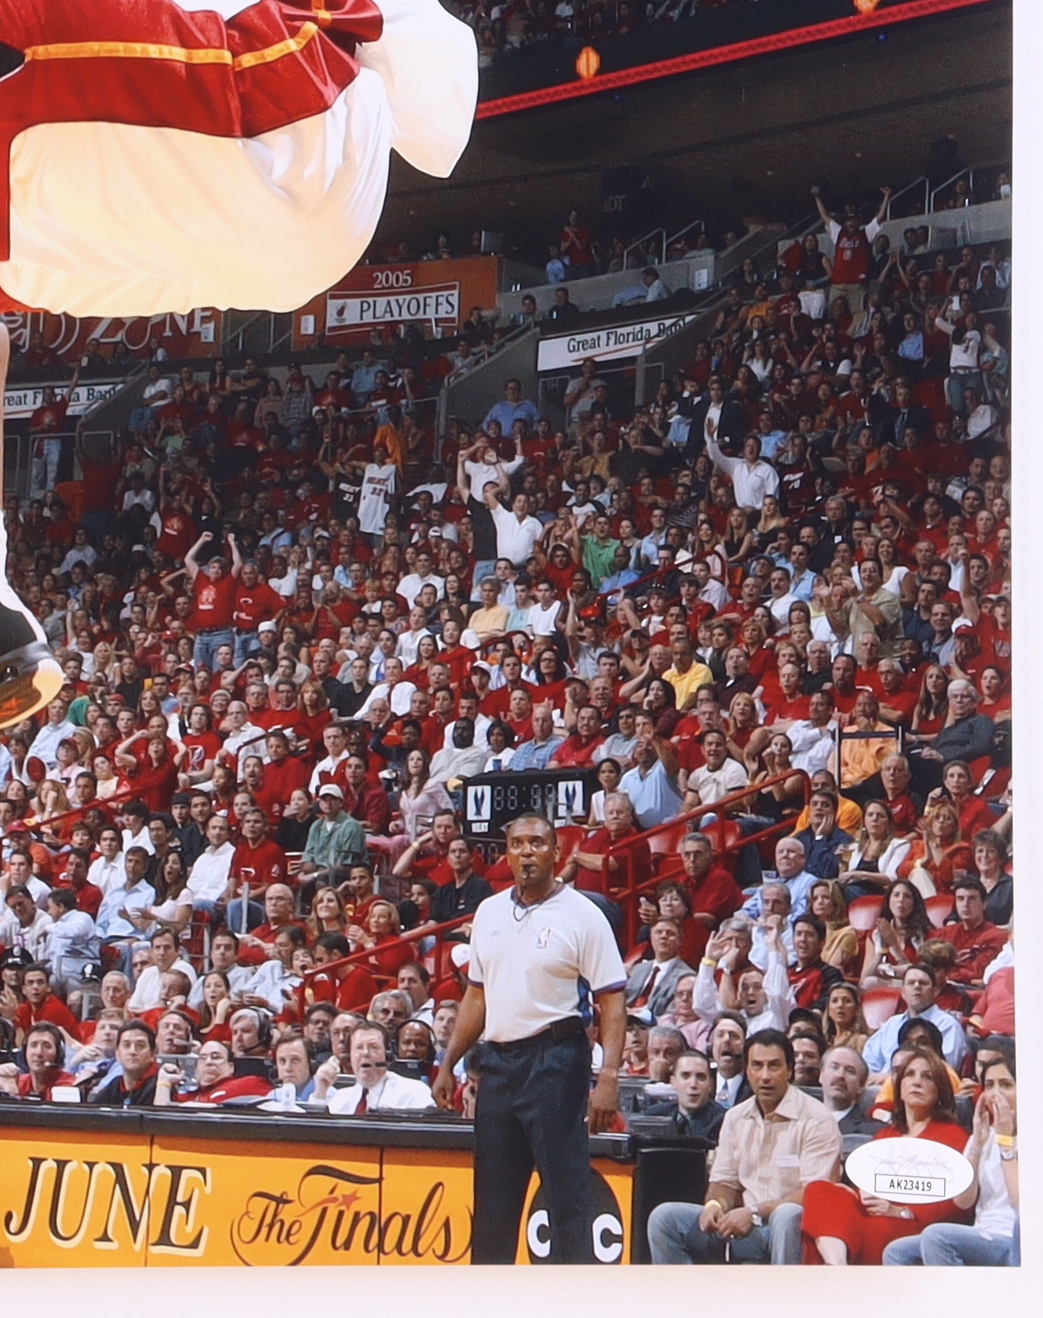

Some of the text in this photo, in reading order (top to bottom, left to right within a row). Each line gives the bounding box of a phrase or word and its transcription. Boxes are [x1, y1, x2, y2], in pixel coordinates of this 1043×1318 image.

[372, 271, 412, 289] 2005
[359, 292, 456, 321] PLAYOFFS
[568, 335, 600, 353] Great
[606, 326, 651, 347] Florida
[4, 393, 28, 406] reat
[889, 1179, 932, 1192] AK23419
[4, 1155, 212, 1257] JUNE
[238, 1164, 456, 1262] The Finals
